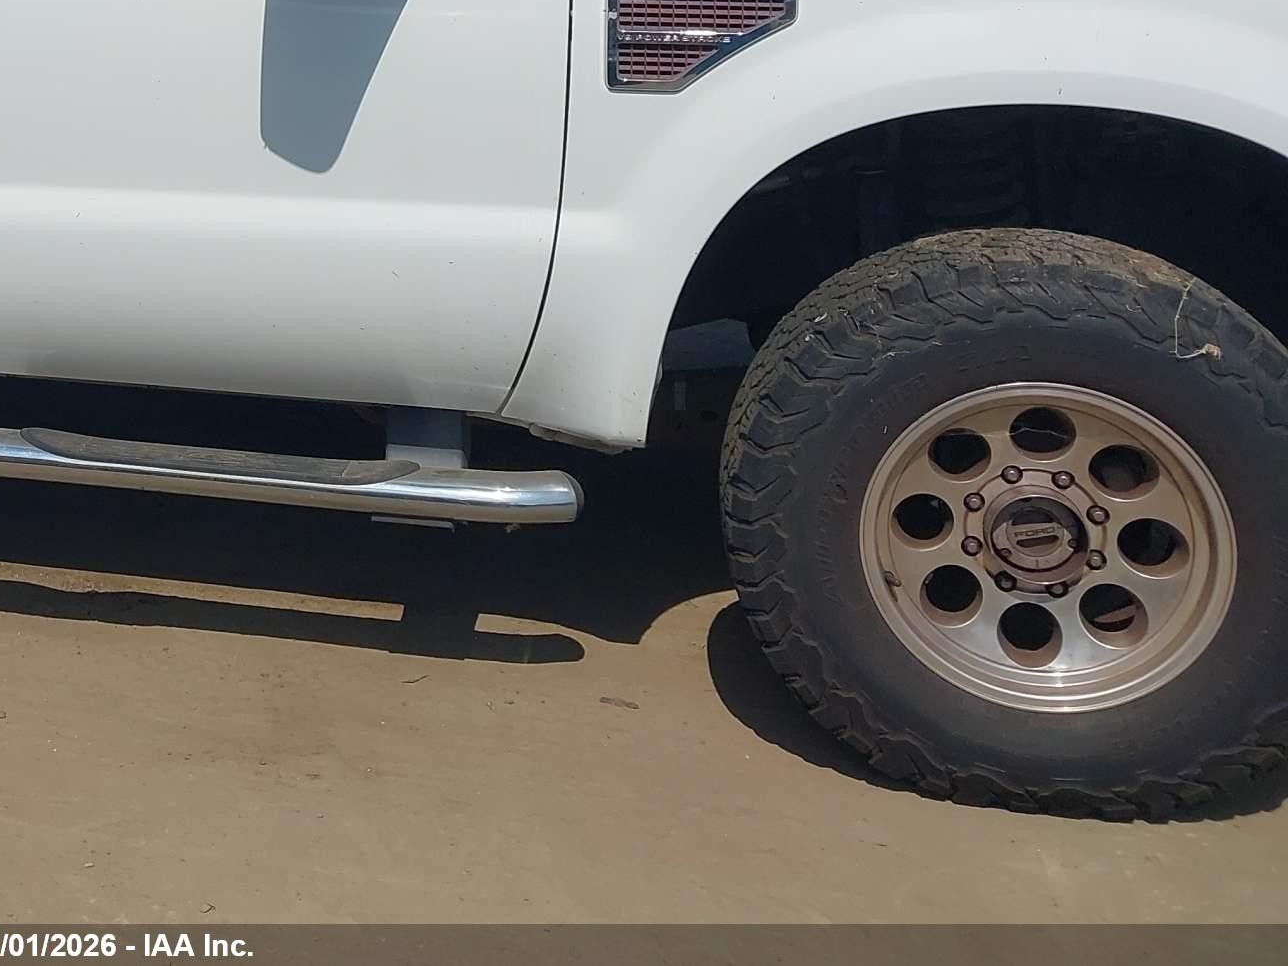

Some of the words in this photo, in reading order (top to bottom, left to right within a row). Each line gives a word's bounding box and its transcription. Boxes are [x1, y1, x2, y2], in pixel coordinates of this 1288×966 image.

[635, 34, 681, 42] POWER
[682, 35, 731, 44] STROKE
[1014, 526, 1055, 538] FORD
